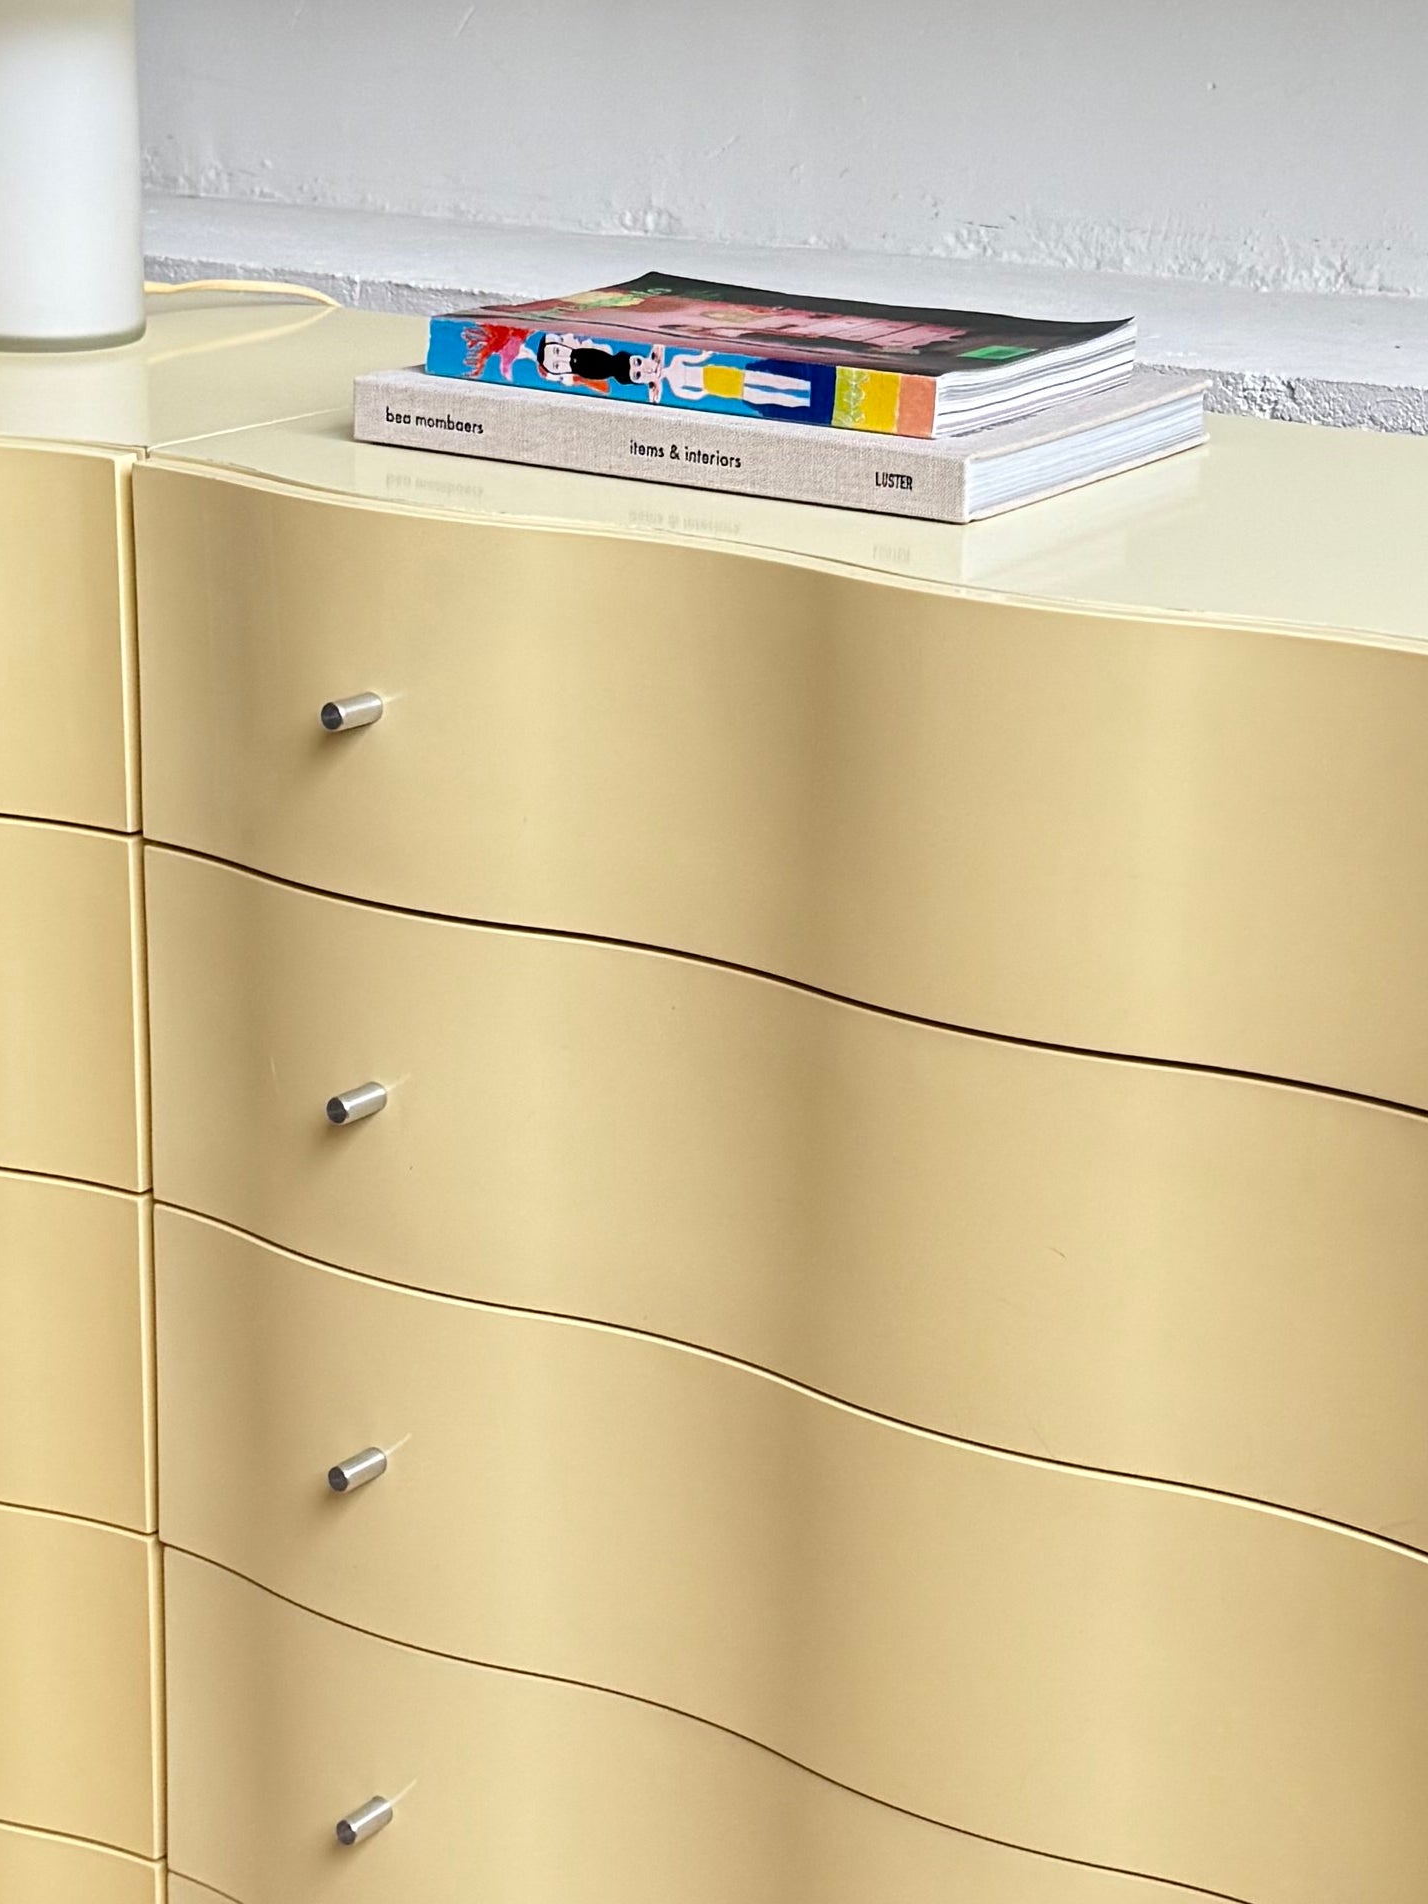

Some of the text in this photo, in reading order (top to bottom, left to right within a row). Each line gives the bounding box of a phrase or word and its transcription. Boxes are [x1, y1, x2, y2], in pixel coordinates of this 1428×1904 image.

[385, 405, 484, 434] bea mombaers
[629, 439, 742, 468] items & interiors
[875, 471, 913, 492] LUSTER
